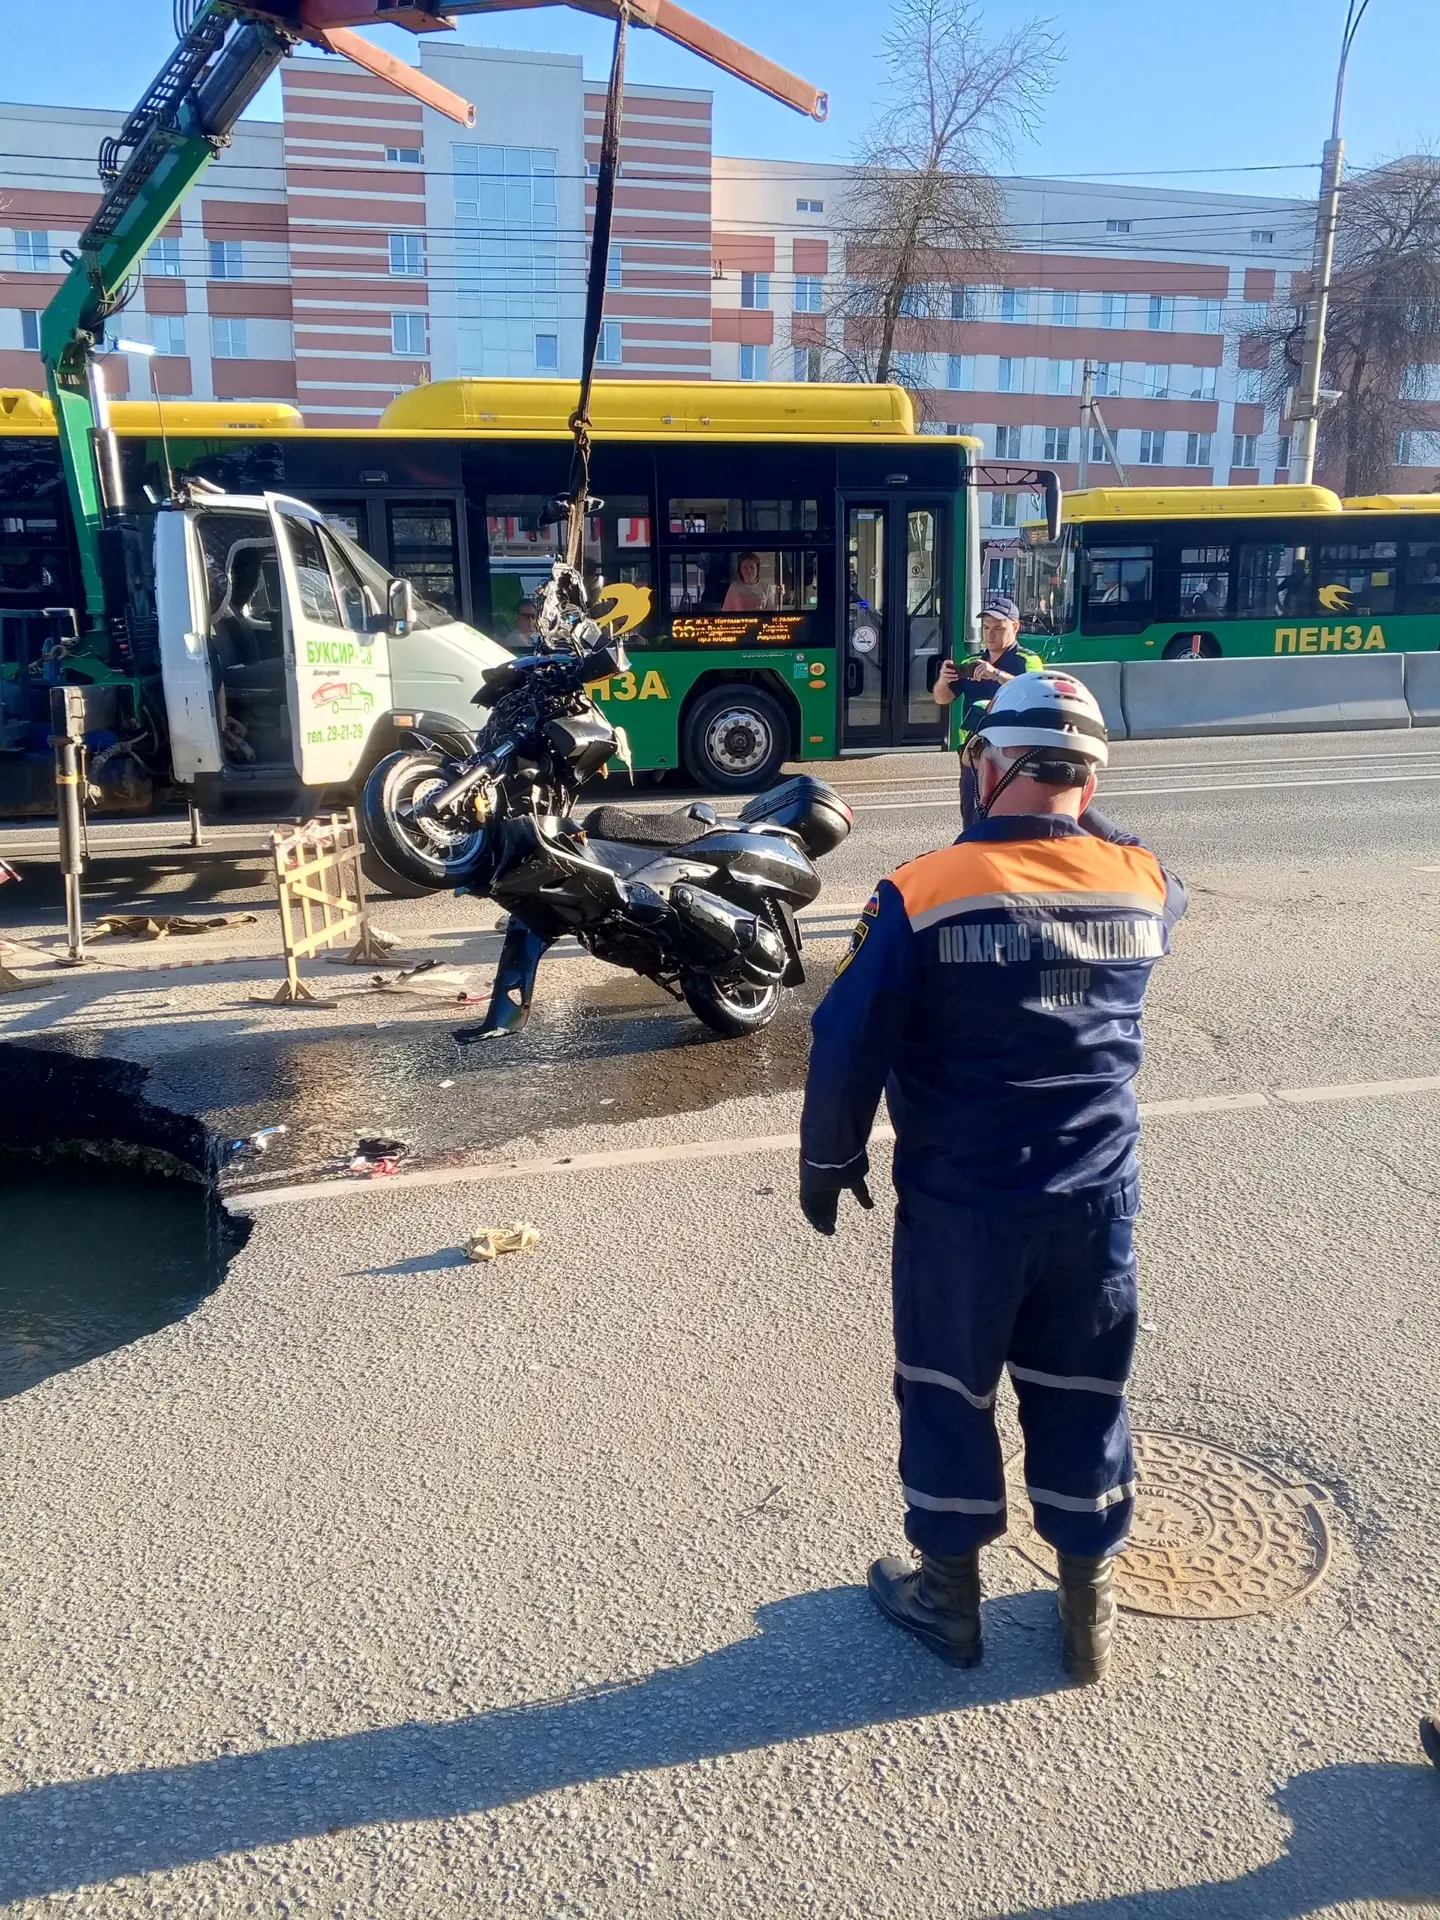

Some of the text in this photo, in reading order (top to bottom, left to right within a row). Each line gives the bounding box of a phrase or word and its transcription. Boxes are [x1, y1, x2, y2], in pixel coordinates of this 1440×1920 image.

[1275, 625, 1386, 653] ПЕНЗА
[584, 670, 672, 701] НЗА
[307, 723, 363, 744] тел. 29-21-29
[1040, 967, 1091, 1012] ЦЕНТР
